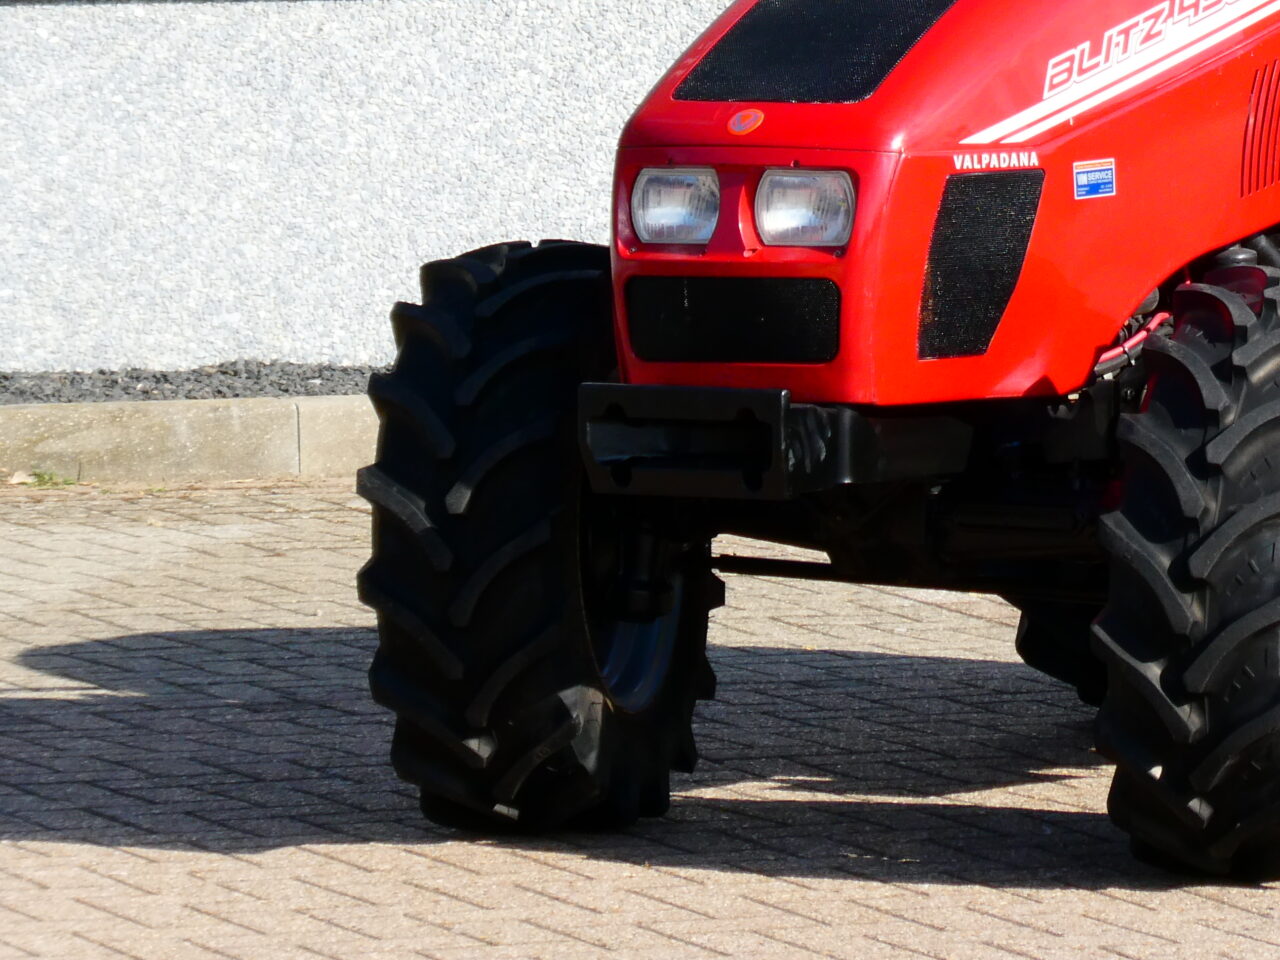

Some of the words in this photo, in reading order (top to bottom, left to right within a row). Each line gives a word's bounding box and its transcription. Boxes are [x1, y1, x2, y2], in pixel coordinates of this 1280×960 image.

[1044, 1, 1170, 98] BLITZ
[953, 151, 1039, 170] VALPADANA
[1087, 170, 1113, 182] SERVICE
